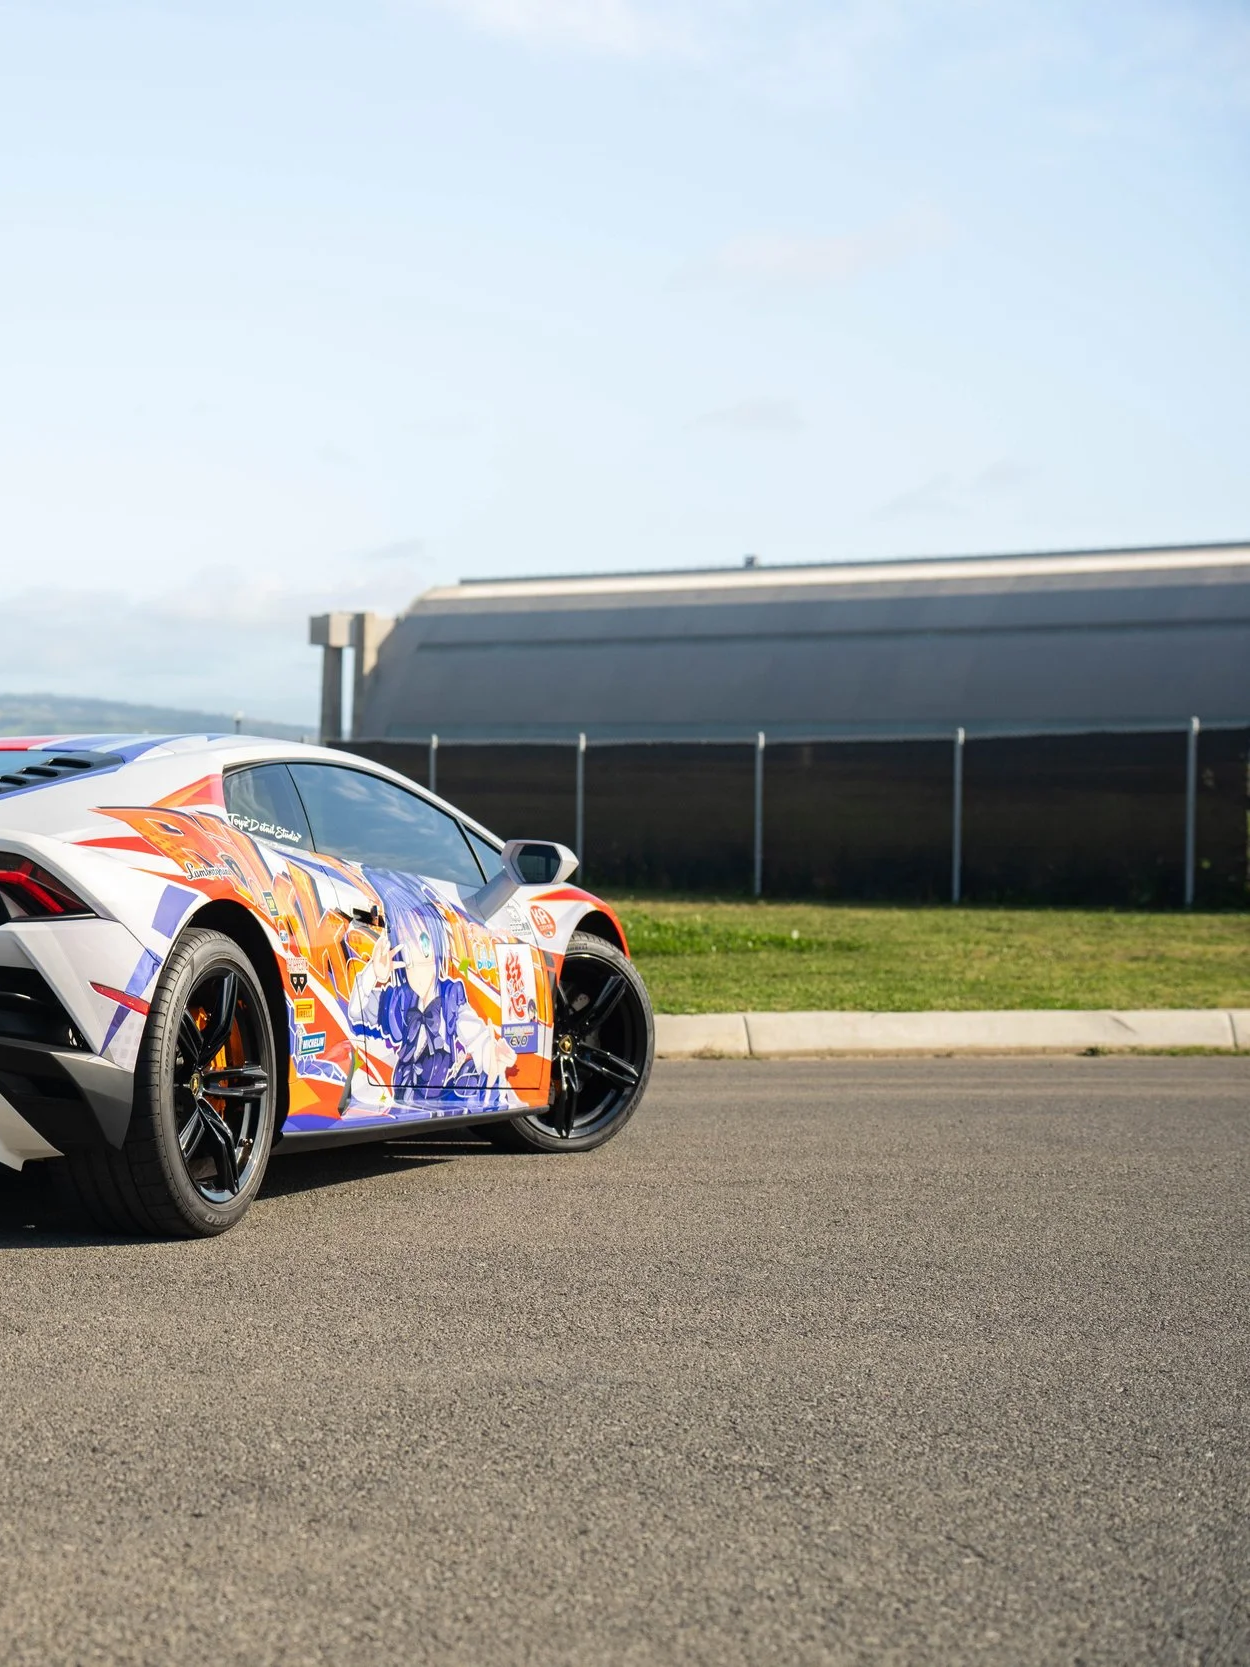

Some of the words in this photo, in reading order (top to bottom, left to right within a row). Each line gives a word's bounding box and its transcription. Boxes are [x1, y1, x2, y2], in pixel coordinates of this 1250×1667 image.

[249, 819, 275, 835] Detail
[275, 826, 301, 842] Studio
[296, 1004, 313, 1018] PIRELLI
[302, 1036, 325, 1050] MICHELIN
[205, 1213, 234, 1226] ERO
